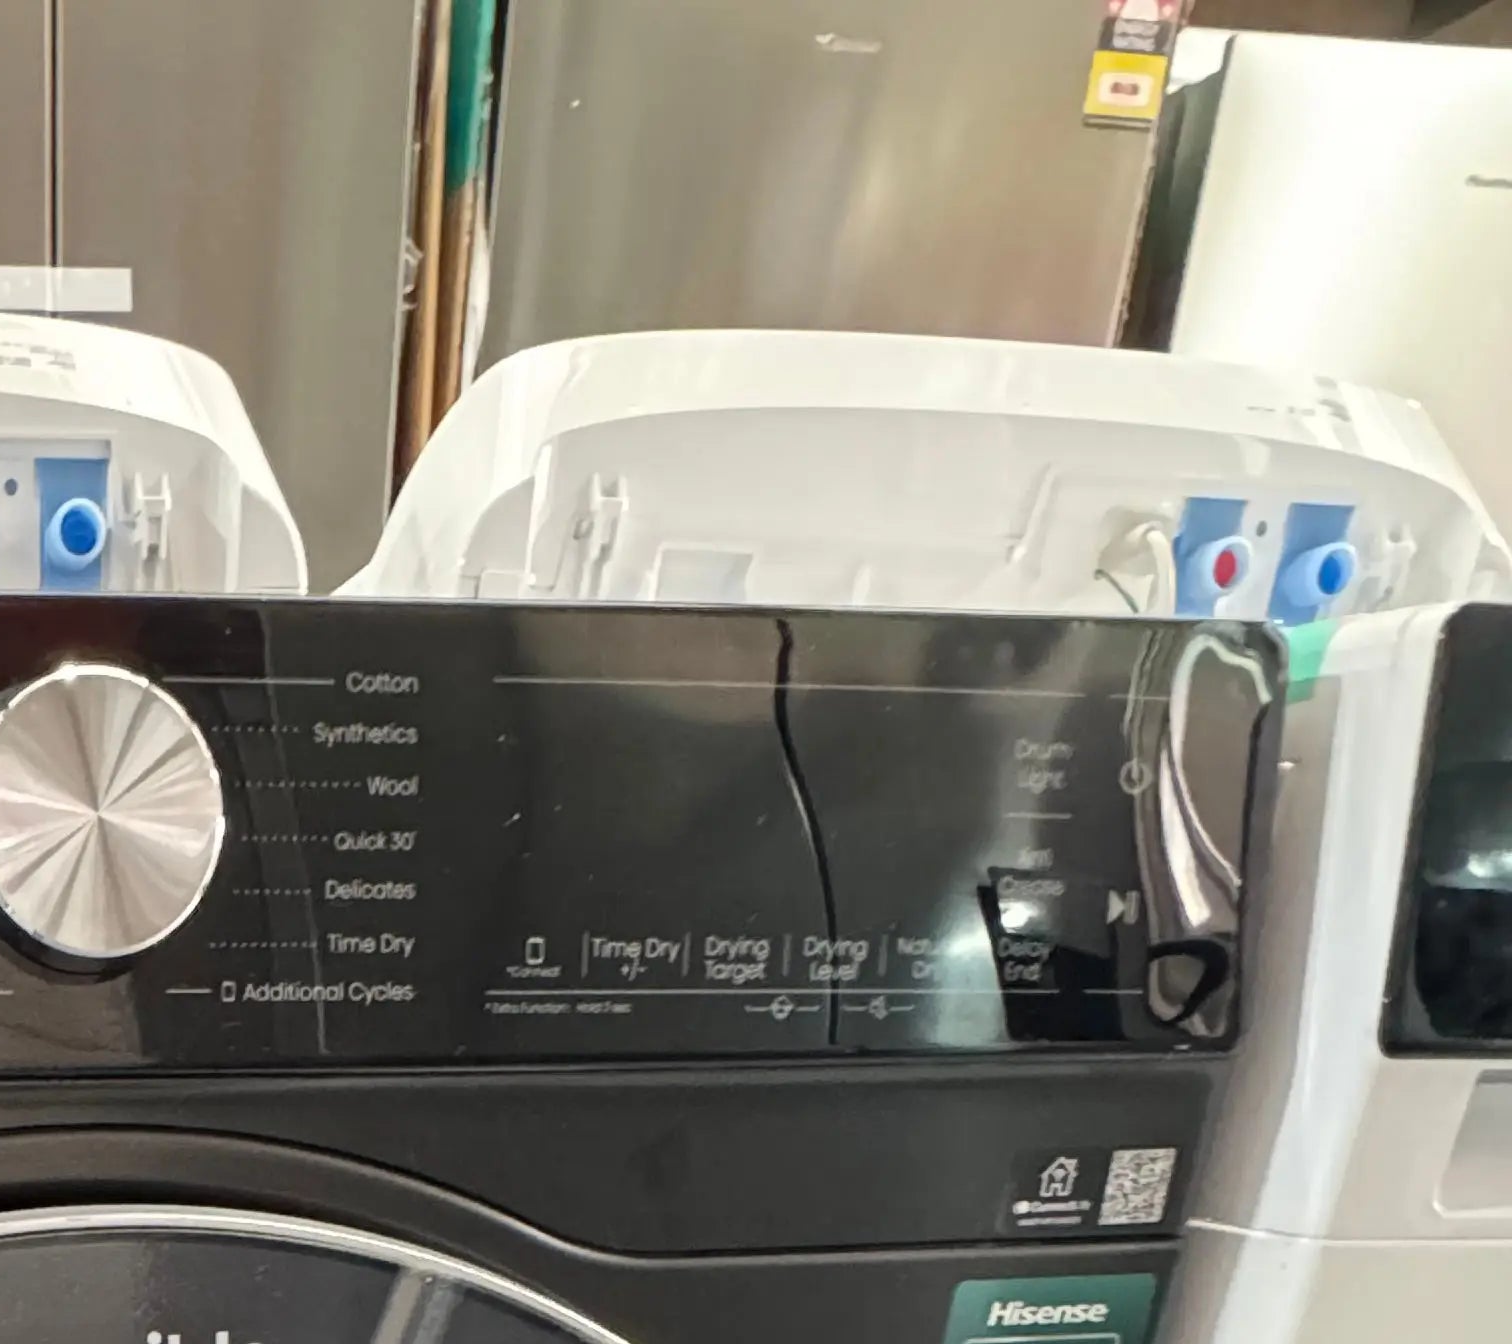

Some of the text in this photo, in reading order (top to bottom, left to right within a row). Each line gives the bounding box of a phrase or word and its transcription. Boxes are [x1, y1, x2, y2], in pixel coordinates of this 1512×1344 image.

[345, 672, 419, 694] Cotton
[312, 721, 419, 748] Synthetics
[366, 774, 419, 797] Wool
[334, 831, 386, 850] Quick
[324, 879, 417, 900] Delicates
[326, 933, 416, 958] Time Dry
[591, 936, 681, 963] Time Dry
[704, 935, 770, 961] Drying
[802, 936, 870, 962] Drying
[704, 960, 767, 984] Target
[808, 961, 860, 982] Level
[242, 982, 418, 1006] Additional Cycles
[987, 1301, 1110, 1327] Hisense
